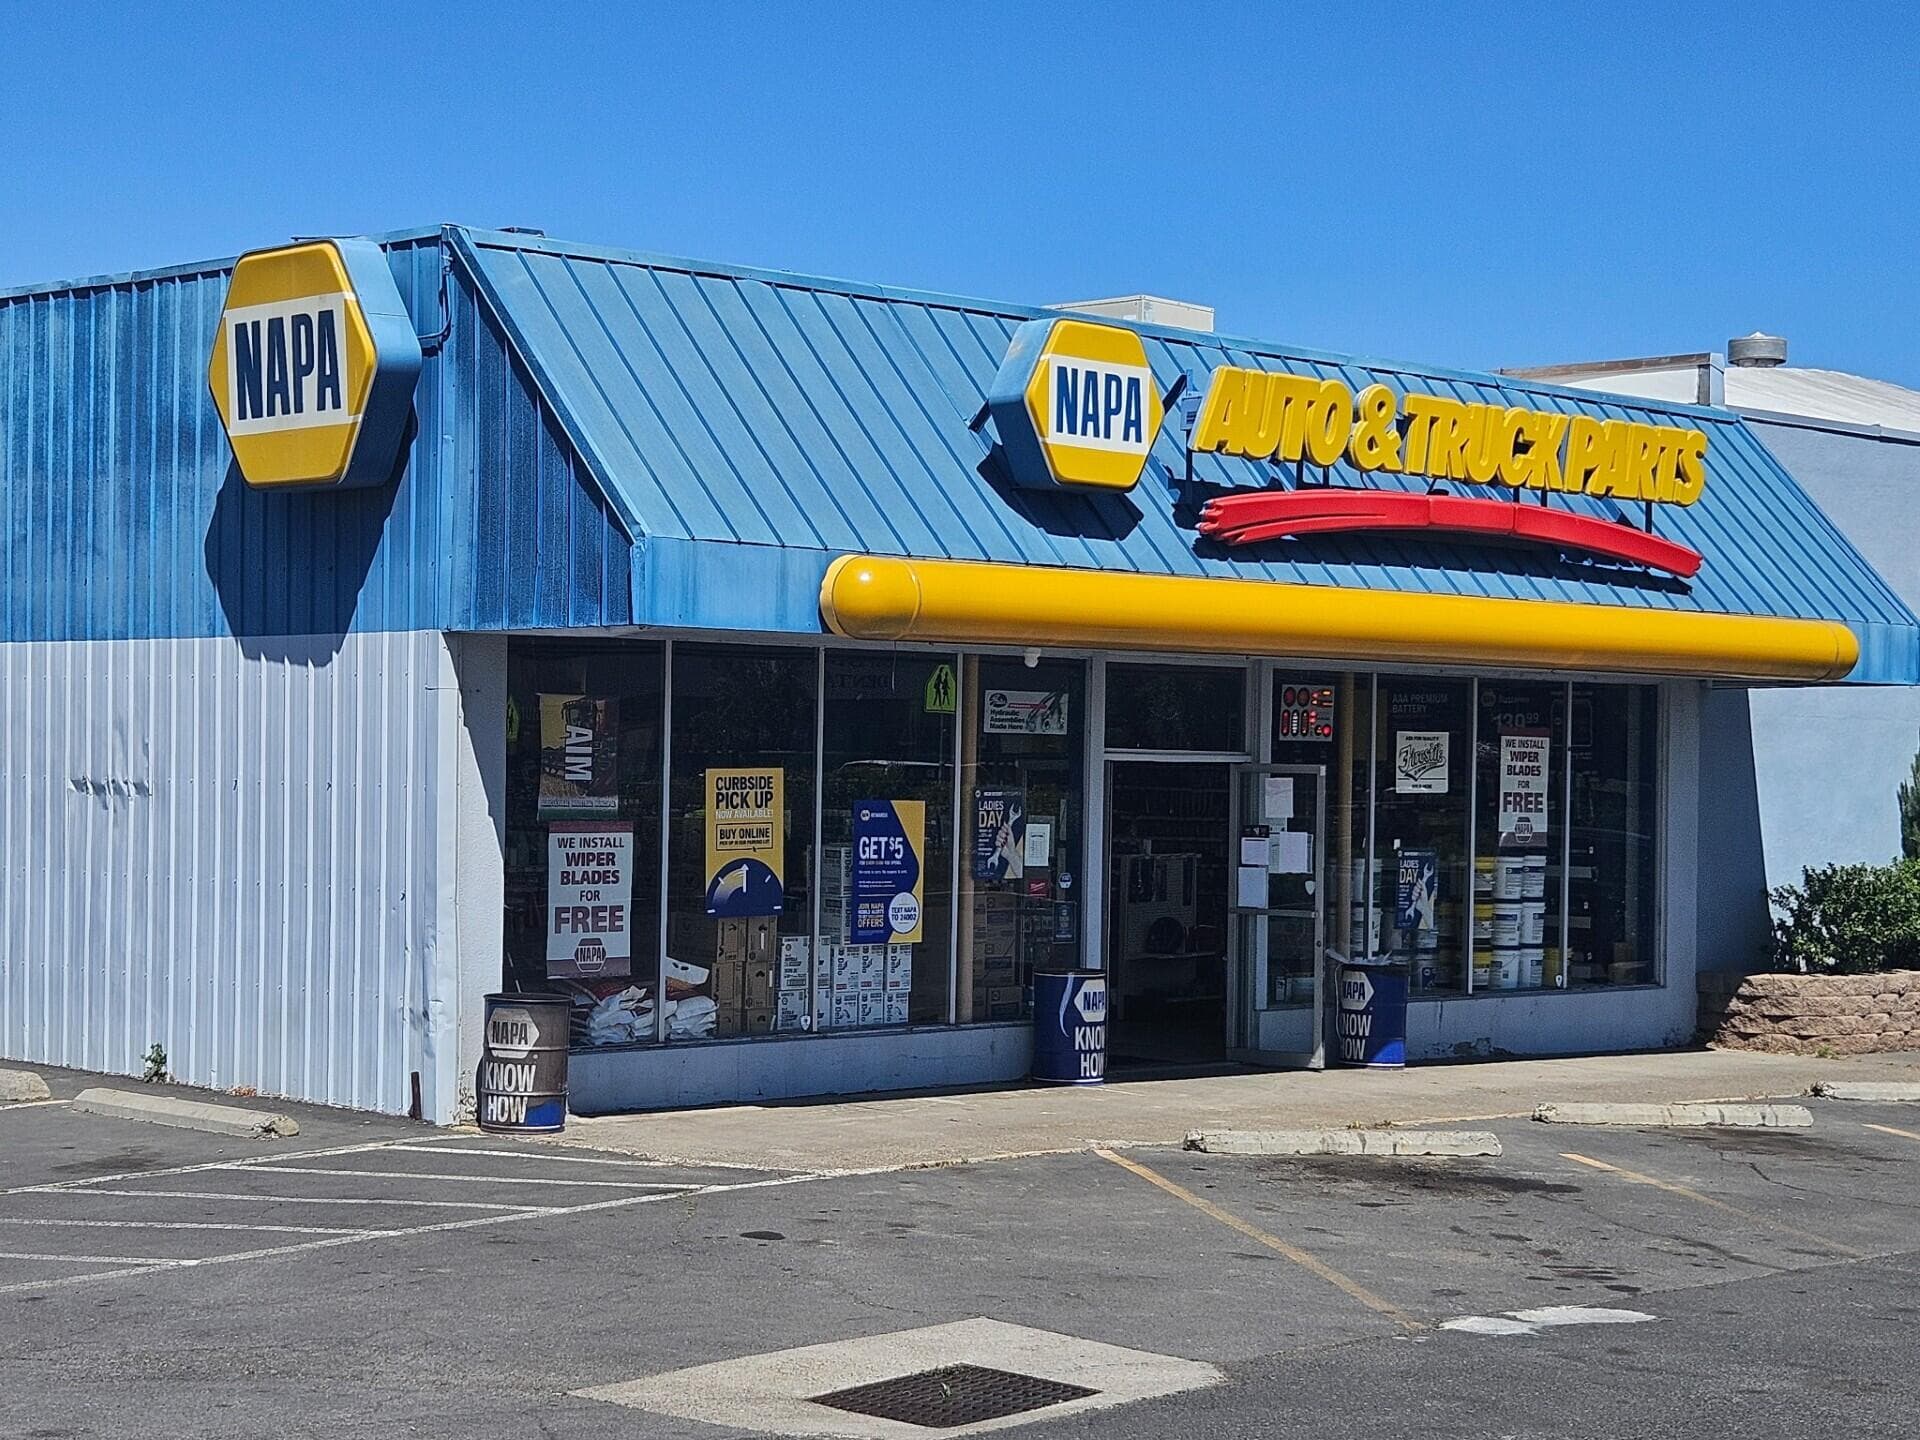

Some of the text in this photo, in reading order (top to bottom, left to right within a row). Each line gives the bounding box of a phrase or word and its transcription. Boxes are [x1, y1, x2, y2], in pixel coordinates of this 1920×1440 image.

[234, 309, 342, 421] NAPA
[1055, 366, 1143, 443] NAPA
[1192, 365, 1707, 507] AUTO & TRUCK PARTS
[1391, 704, 1427, 714] BATTERY
[1505, 738, 1544, 749] WE INSTALL
[564, 725, 592, 780] AIM
[1510, 751, 1539, 762] WIPER
[1507, 765, 1541, 776] BLADES
[716, 776, 773, 790] CURBSIDE
[1518, 780, 1530, 789] FOR
[716, 791, 773, 809] PICK UP
[979, 801, 1004, 811] LADIES
[1503, 792, 1543, 813] FREE
[979, 811, 1003, 828] DAY
[720, 828, 770, 839] BUY ONLINE
[557, 837, 624, 849] WE INSTALL
[859, 836, 904, 860] GET $5
[565, 852, 616, 867] WIPER
[1399, 860, 1419, 868] LADIES
[560, 870, 620, 885] BLADES
[1399, 869, 1418, 883] DAY
[580, 890, 600, 901] FOR
[554, 905, 624, 934] FREE
[858, 919, 884, 928] OFFERS
[579, 948, 601, 962] NAPA
[492, 1020, 529, 1046] NAPA
[485, 1061, 537, 1093] KNOW
[487, 1095, 528, 1124] HOW
